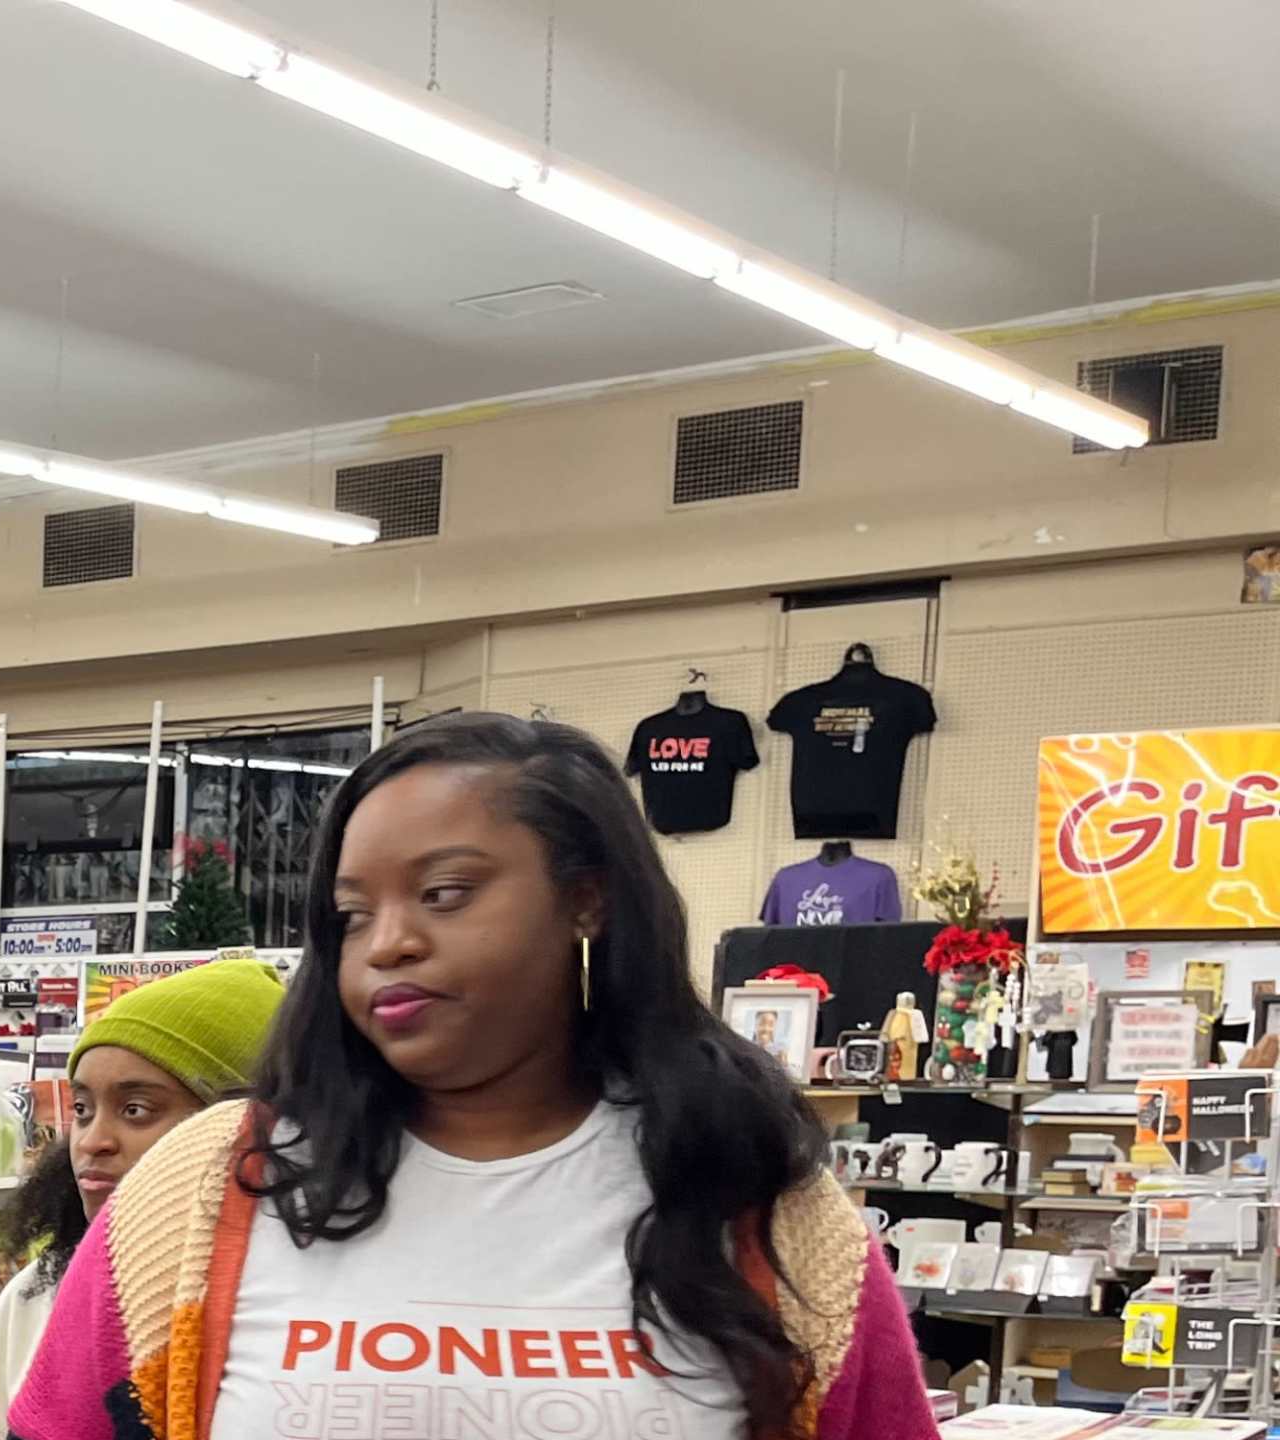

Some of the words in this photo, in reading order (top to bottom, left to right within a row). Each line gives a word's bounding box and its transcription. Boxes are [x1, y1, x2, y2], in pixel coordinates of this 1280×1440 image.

[648, 738, 711, 759] LOVE
[1056, 772, 1280, 876] Gif
[1189, 1320, 1215, 1330] THE
[1187, 1330, 1223, 1341] LONG
[281, 1319, 672, 1380] PIONEER
[1186, 1340, 1217, 1351] TRIP
